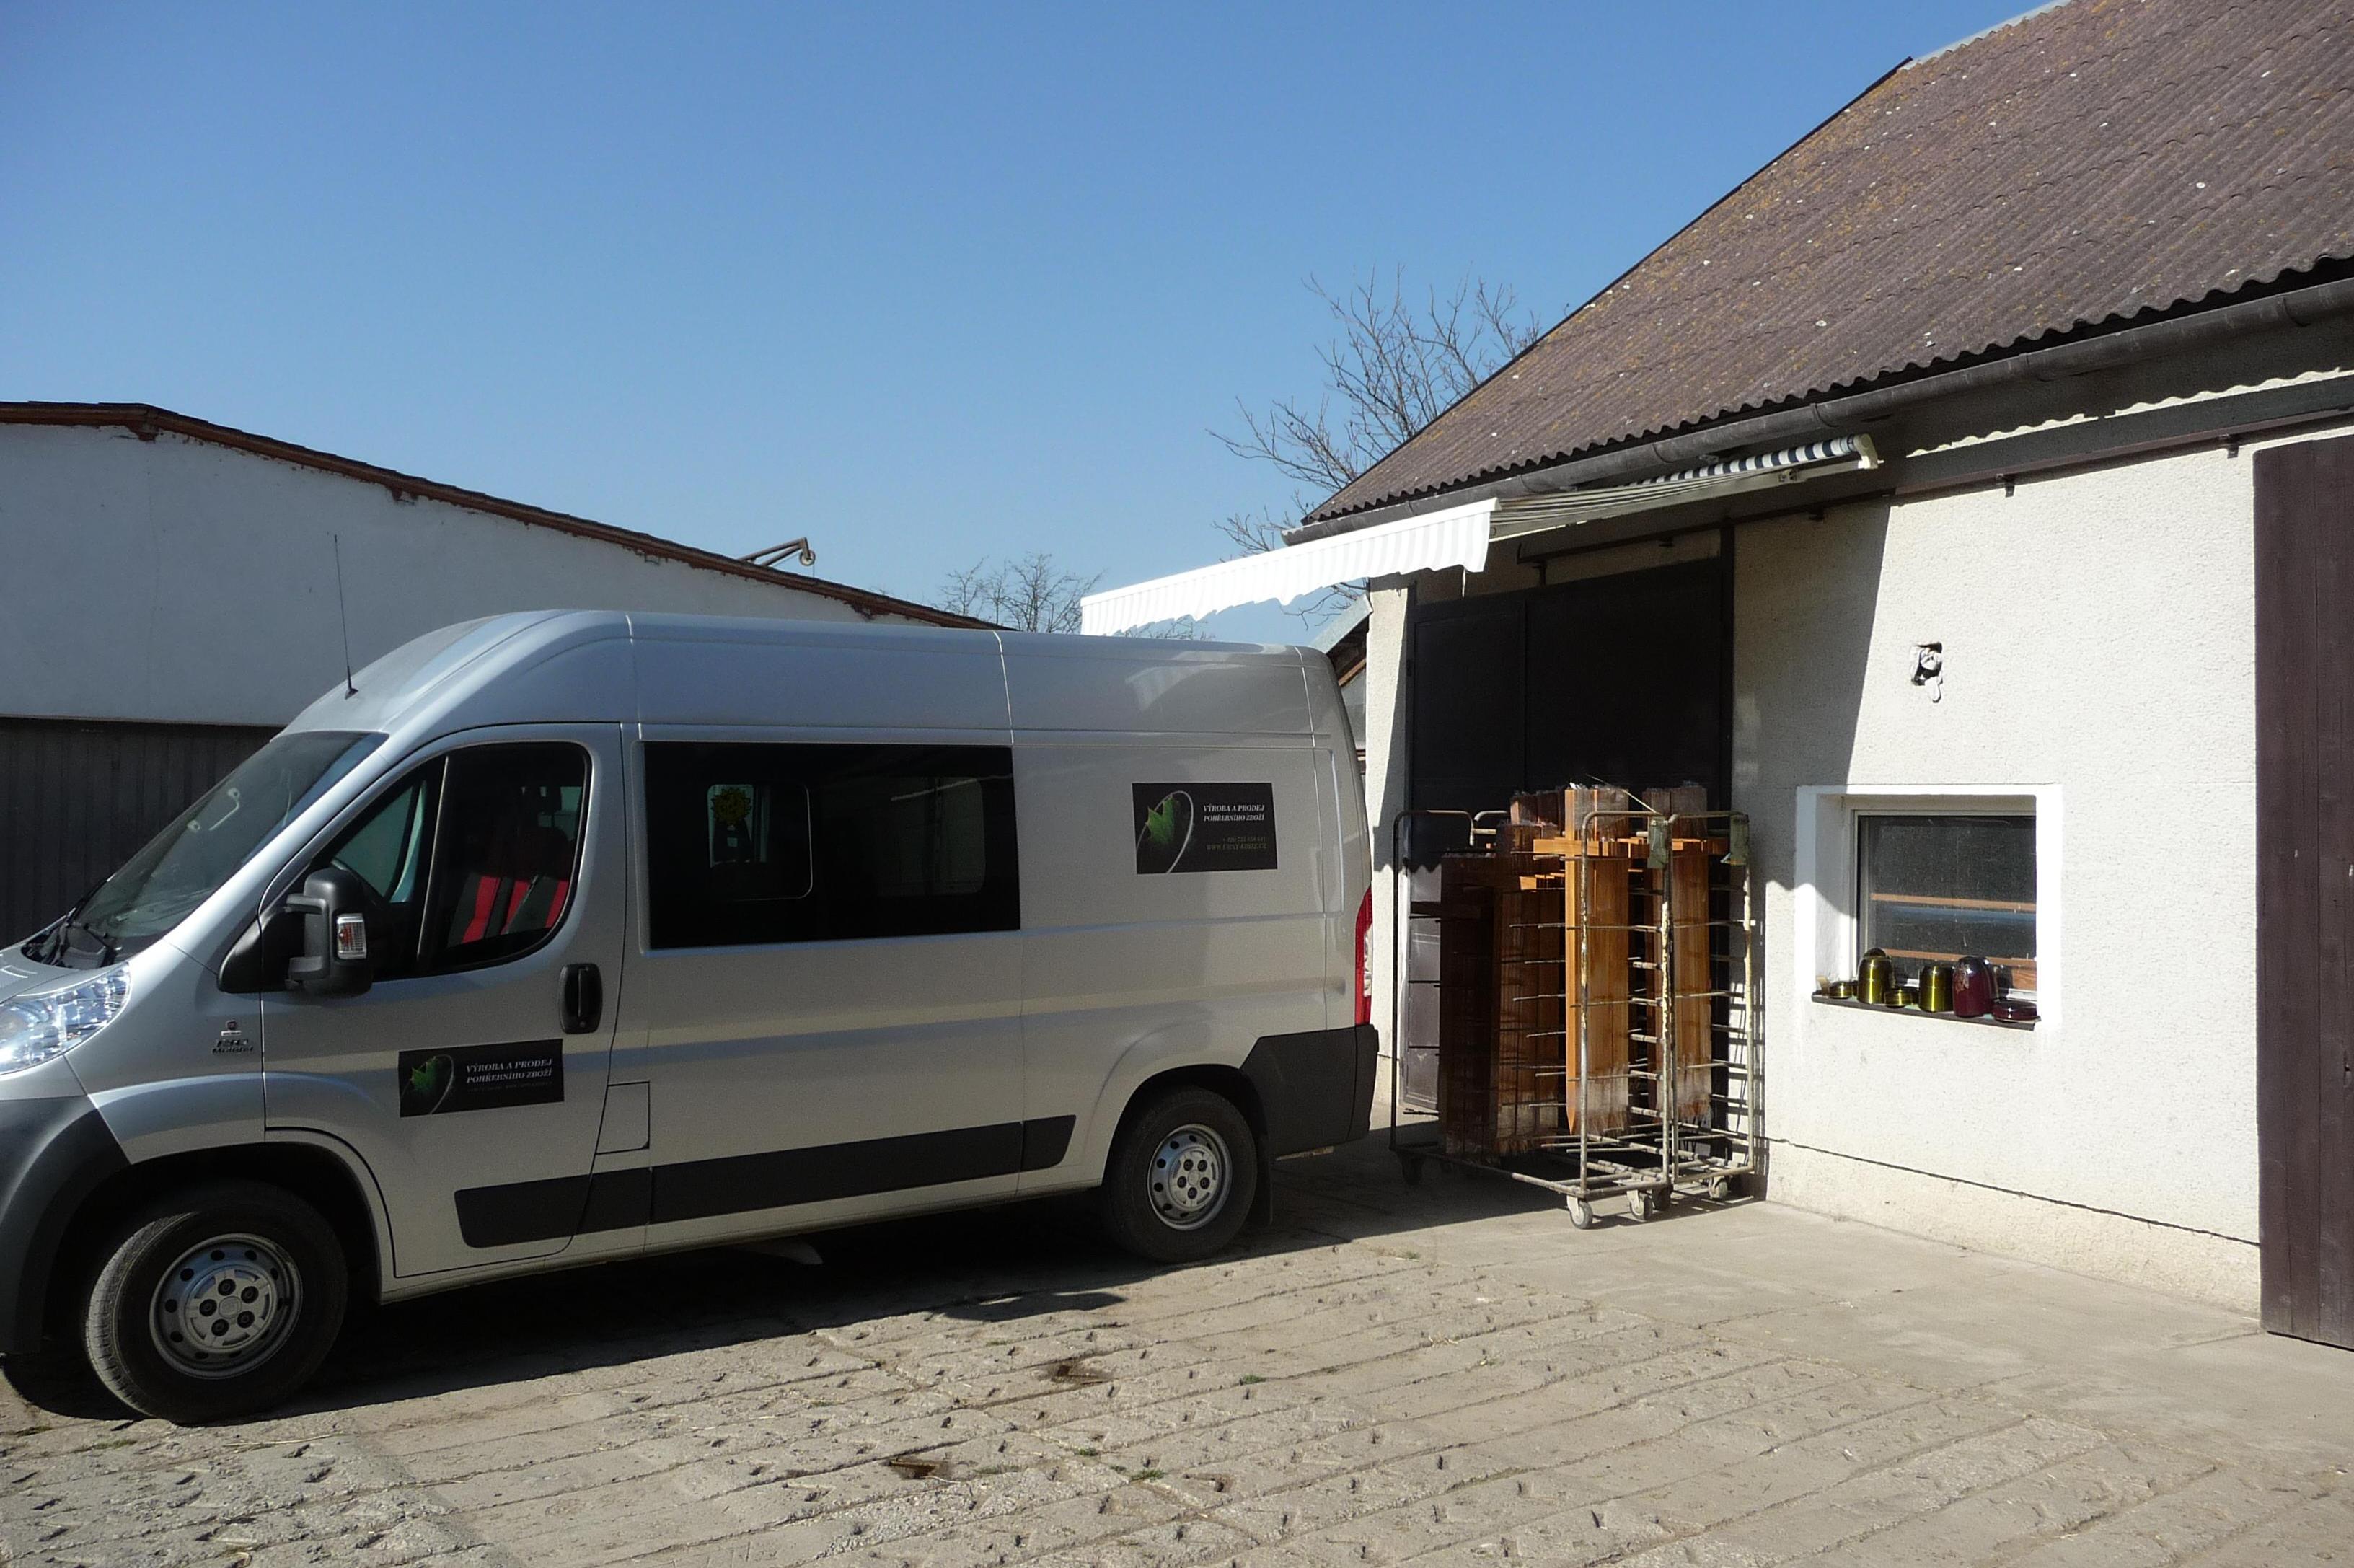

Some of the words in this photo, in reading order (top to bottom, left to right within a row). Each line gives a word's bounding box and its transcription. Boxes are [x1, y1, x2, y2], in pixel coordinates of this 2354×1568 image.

[1203, 803, 1230, 812] VÝROBA
[466, 1062, 503, 1073] VÝROBA
[515, 1058, 552, 1068] PRODEJ
[467, 1071, 525, 1083] POHŘEBNÍHO
[526, 1067, 552, 1078] ZBOŽÍ
